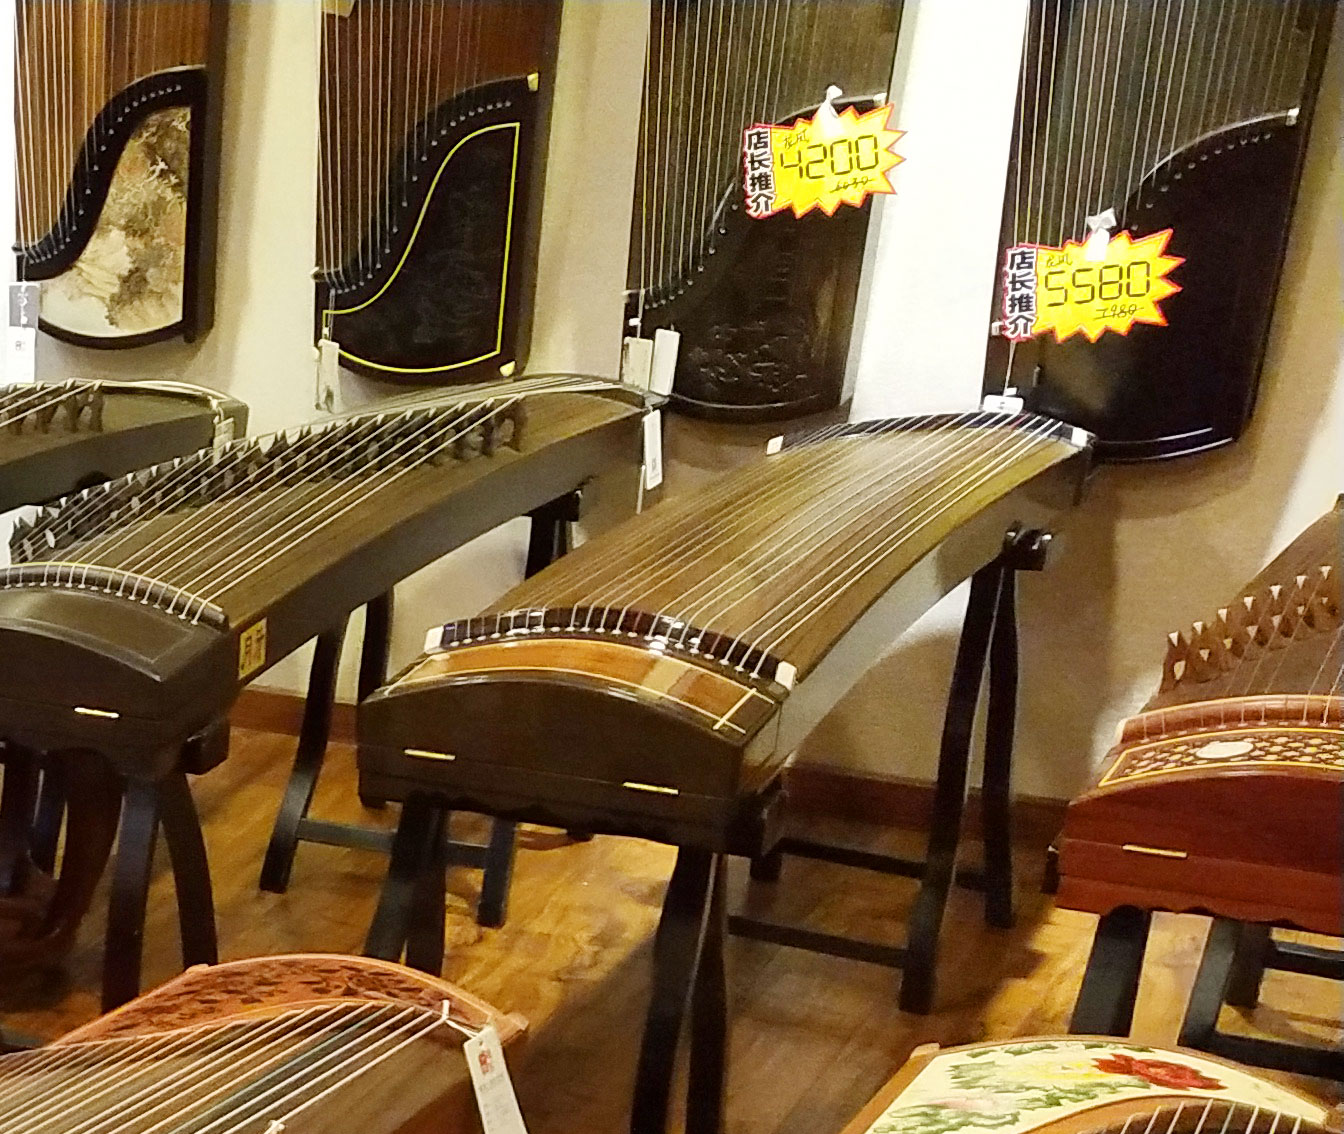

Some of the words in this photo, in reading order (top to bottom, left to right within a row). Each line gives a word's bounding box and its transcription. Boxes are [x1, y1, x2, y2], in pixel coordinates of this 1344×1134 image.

[747, 129, 773, 214] 店长推介
[780, 134, 879, 179] 4200
[1008, 249, 1035, 336] 店长推介
[1044, 261, 1150, 307] 5580
